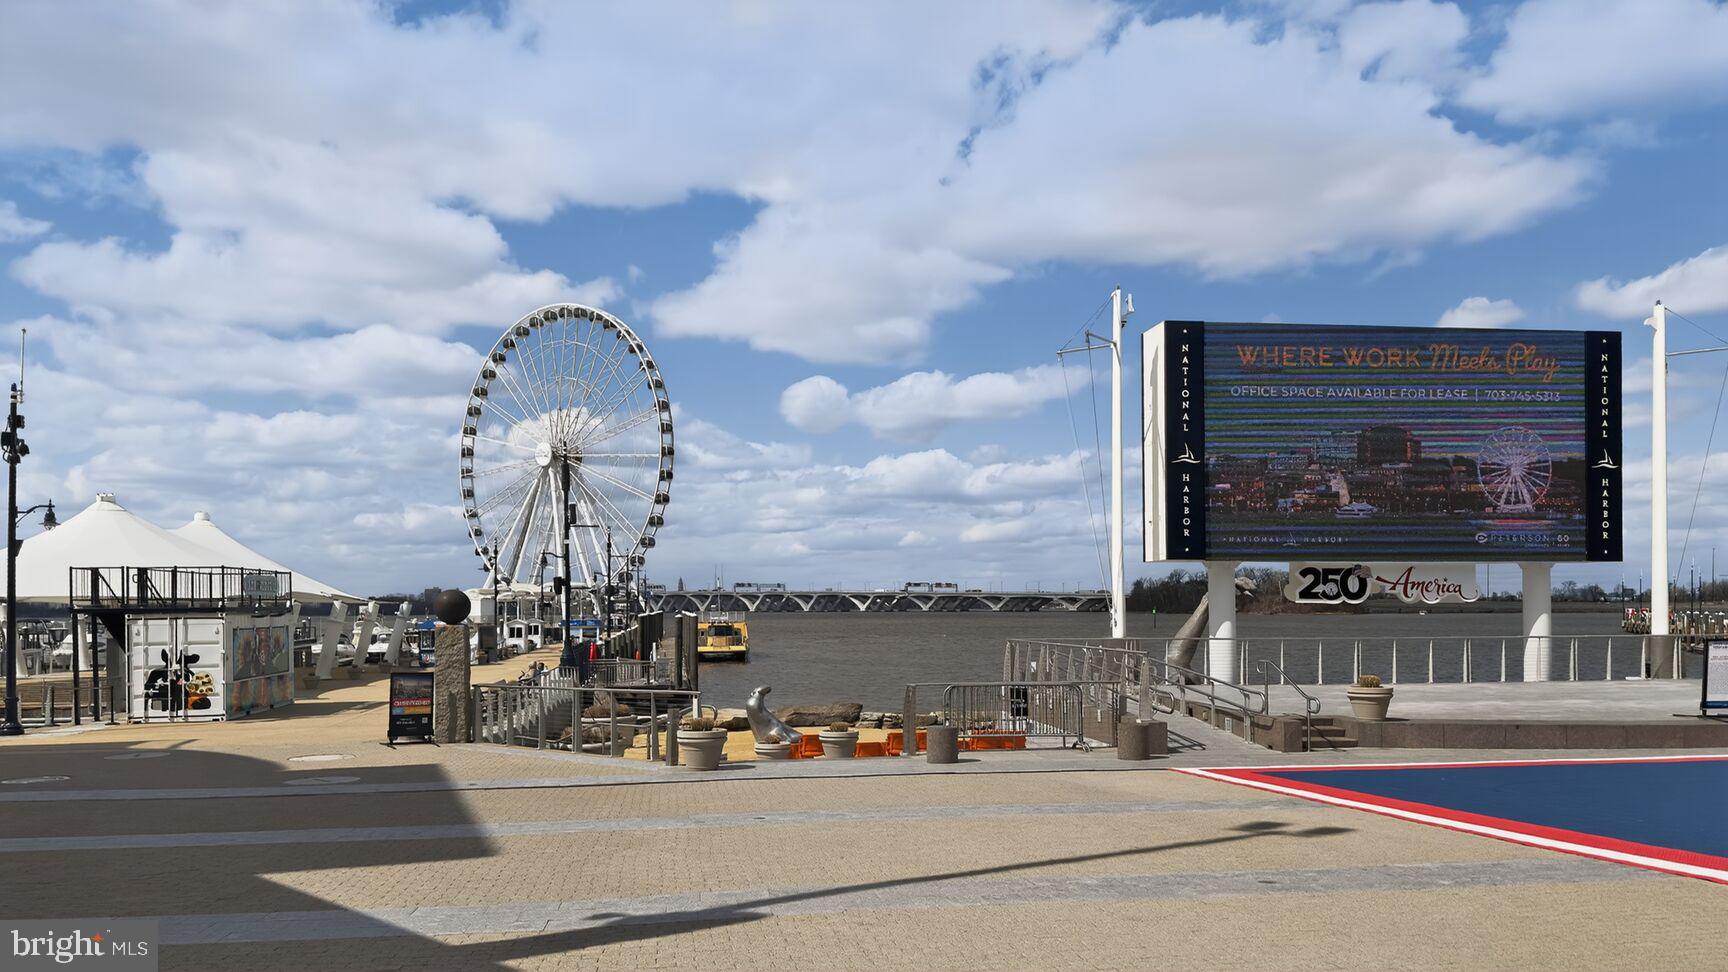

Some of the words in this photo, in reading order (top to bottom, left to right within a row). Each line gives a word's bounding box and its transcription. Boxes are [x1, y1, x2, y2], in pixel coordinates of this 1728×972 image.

[1181, 344, 1190, 431] NATIONAL
[1236, 344, 1334, 367] WHERE
[1343, 346, 1421, 369] WORK
[1428, 343, 1502, 371] Meets
[1505, 341, 1561, 383] Play
[1230, 385, 1279, 397] OFFICE
[1281, 386, 1324, 398] SPACE
[1326, 387, 1398, 400] AVAILABLE
[1400, 388, 1427, 400] FOR
[1429, 389, 1468, 401] LEASE
[1601, 354, 1609, 438] NATIONAL
[1182, 474, 1191, 537] HARBOR
[1601, 479, 1609, 540] HARBOR
[1298, 566, 1370, 601] 250
[1374, 565, 1478, 602] America
